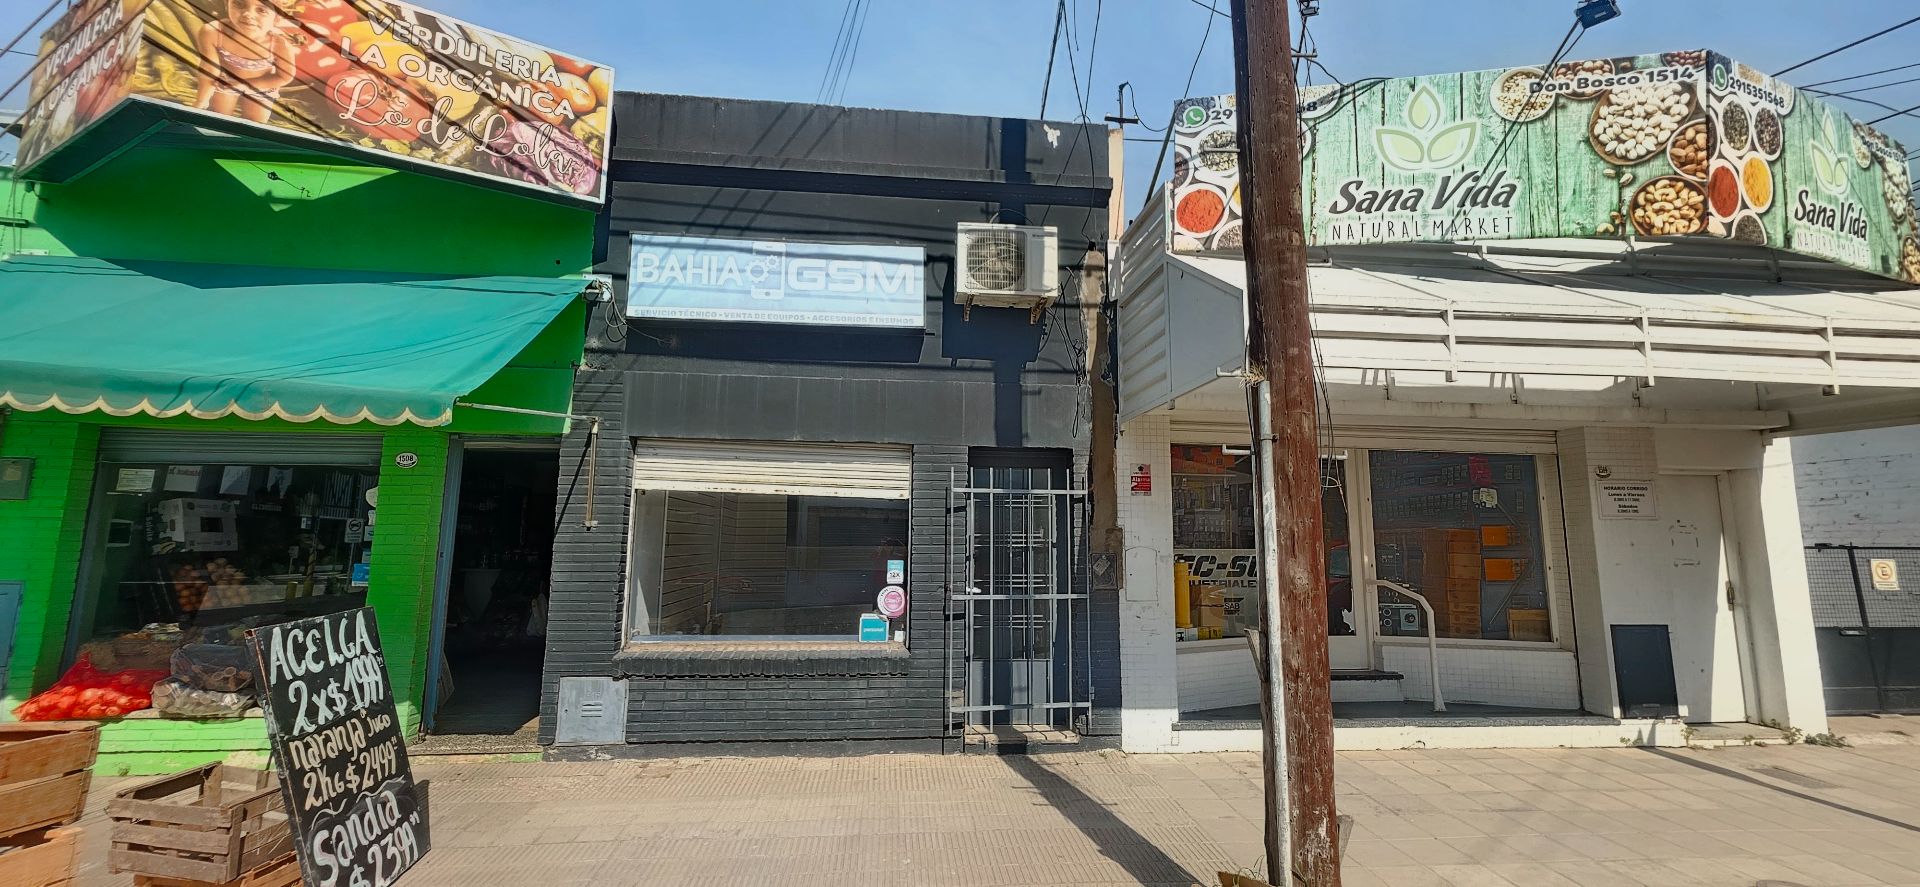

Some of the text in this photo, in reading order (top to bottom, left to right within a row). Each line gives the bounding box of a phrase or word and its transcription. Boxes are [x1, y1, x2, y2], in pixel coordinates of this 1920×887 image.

[368, 11, 562, 88] VERDULERIA
[340, 36, 575, 120] LA ORGÁNICA
[1529, 66, 1696, 94] Don Bosco 1514
[1729, 76, 1785, 109] 2915351568
[334, 79, 412, 128] Lo
[416, 96, 466, 145] de
[1328, 170, 1519, 215] Sana Vida
[1332, 216, 1515, 242] NATURAL MARKET
[1794, 189, 1868, 241] Sana Vida
[636, 252, 916, 295] BAHIA GSM
[634, 309, 676, 318] SERVICIO
[724, 311, 753, 320] VENTA
[767, 313, 806, 321] EQUIPOS
[399, 454, 414, 463] 1508
[270, 611, 378, 687] ACELGA
